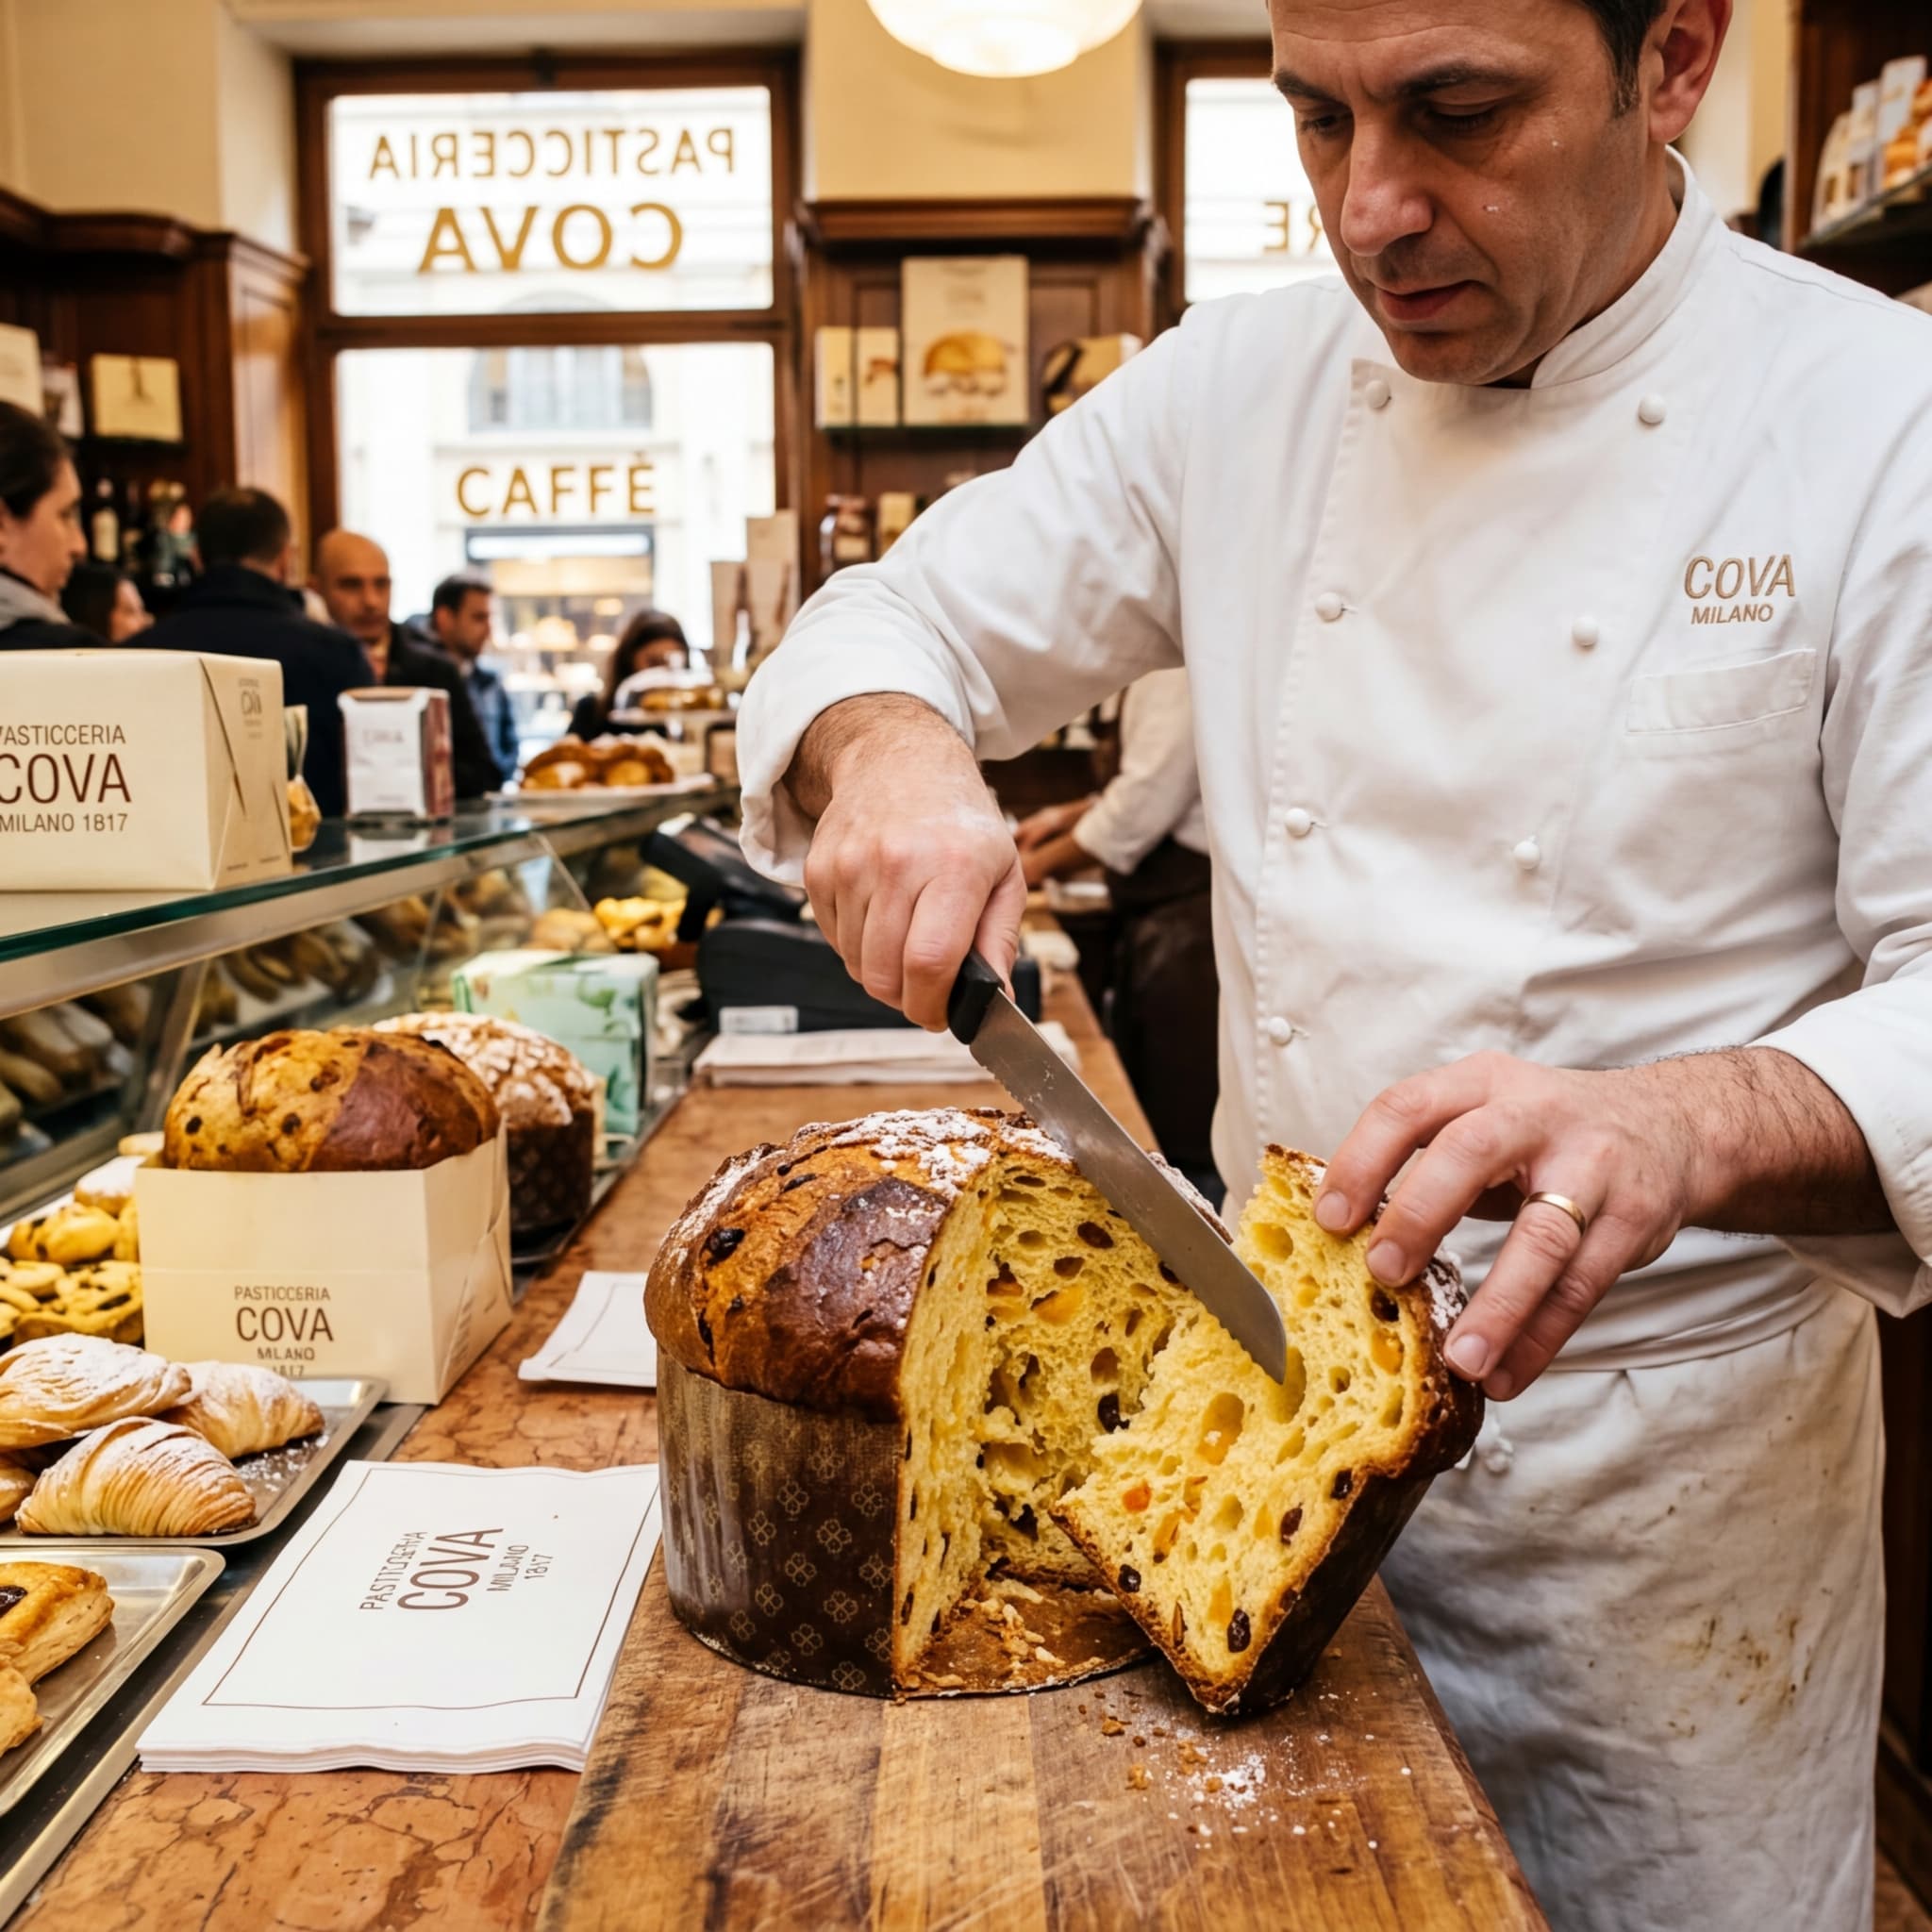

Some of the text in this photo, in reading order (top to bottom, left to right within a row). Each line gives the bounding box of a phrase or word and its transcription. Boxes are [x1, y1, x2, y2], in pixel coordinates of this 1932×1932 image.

[1684, 554, 1796, 599] COVA
[1690, 604, 1774, 625] MILANO
[0, 724, 126, 745] ASTICCERIA
[0, 753, 132, 804] COVA
[83, 813, 128, 832] 1817
[234, 1286, 331, 1301] PASTICCERIA
[236, 1307, 334, 1341] COVA
[397, 1528, 504, 1610] COVA
